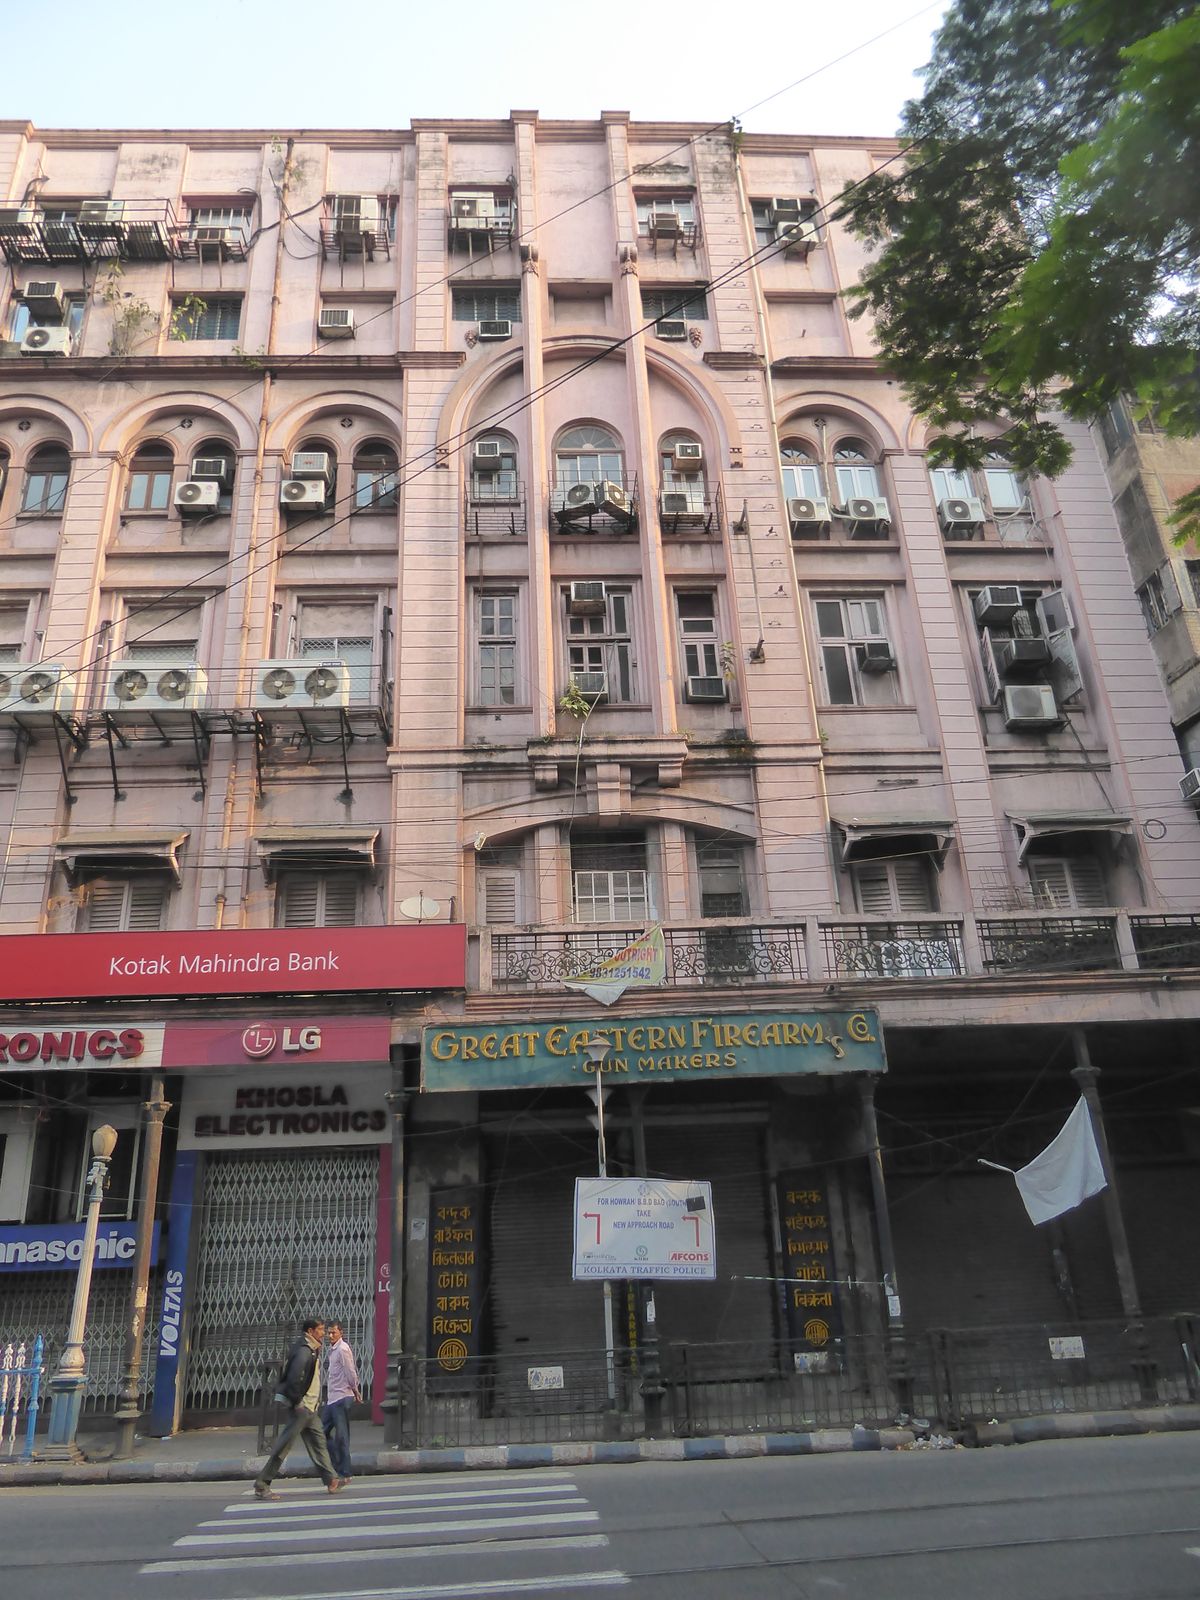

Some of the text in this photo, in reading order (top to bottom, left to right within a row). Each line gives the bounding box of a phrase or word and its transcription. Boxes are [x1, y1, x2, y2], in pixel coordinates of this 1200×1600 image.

[109, 950, 340, 976] Kotak Mahindra Bank
[282, 1026, 322, 1052] LG
[431, 1031, 540, 1061] GREAT
[582, 1052, 737, 1074] GUN MAKERS
[236, 1085, 348, 1109] KHOSLA
[194, 1109, 387, 1137] ELECTRONICS
[597, 1198, 609, 1206] FOR
[637, 1209, 651, 1217] TAKE
[613, 1221, 675, 1230] NEW APPROACH ROAD
[583, 1266, 706, 1275] KOLKATA TRAFFIC POLICE
[160, 1270, 183, 1355] VOLTAS
